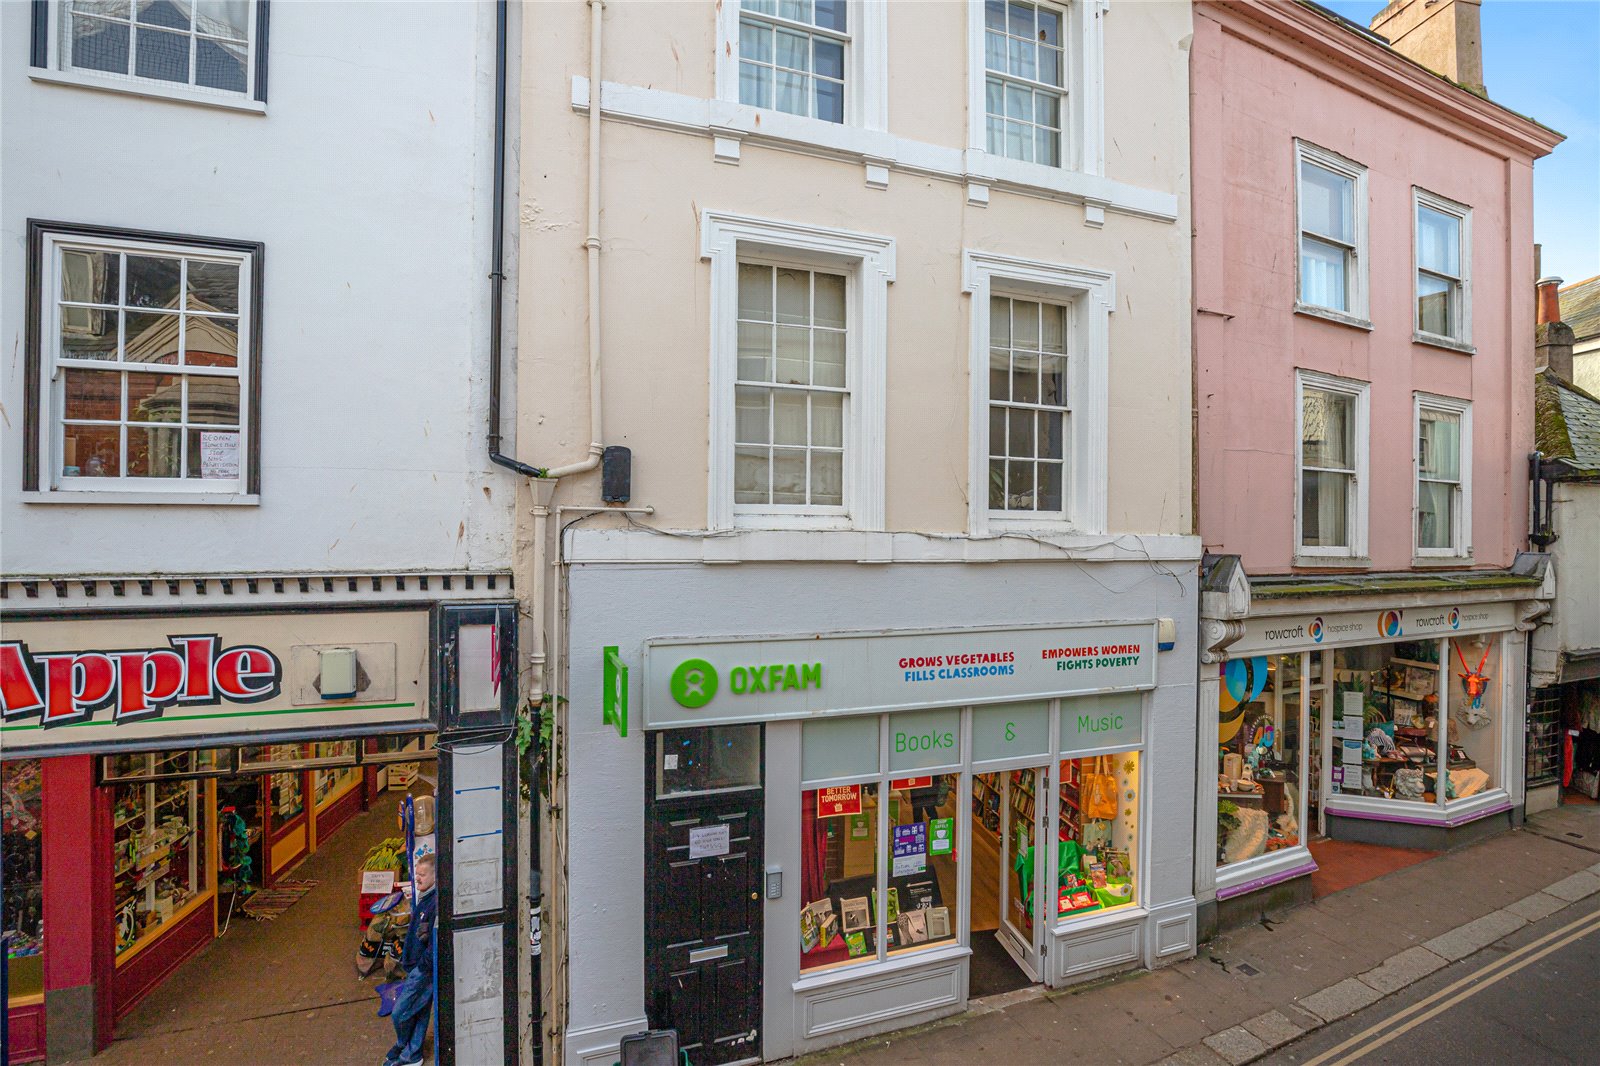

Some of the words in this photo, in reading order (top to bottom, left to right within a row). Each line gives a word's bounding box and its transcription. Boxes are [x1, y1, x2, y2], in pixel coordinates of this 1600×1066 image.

[1327, 624, 1348, 634] hospice
[1349, 622, 1363, 632] shop
[1416, 614, 1445, 627] rowcroft
[1265, 625, 1304, 640] rowcroft
[1042, 646, 1099, 659] EMPOWERS
[1101, 644, 1140, 655] WOMEN
[899, 656, 943, 668] GROWS
[946, 652, 1015, 666] VEGETABLES
[1056, 659, 1094, 671] FIGHTS
[1095, 656, 1140, 668] POVERTY
[730, 662, 822, 695] OXFAM
[905, 670, 936, 682] FILLS
[938, 665, 1015, 679] CLASSROOMS
[1078, 712, 1124, 733] Music
[1004, 722, 1016, 741] &
[895, 730, 954, 752] Books
[821, 793, 857, 803] TOMORROW
[827, 786, 851, 795] BETTER
